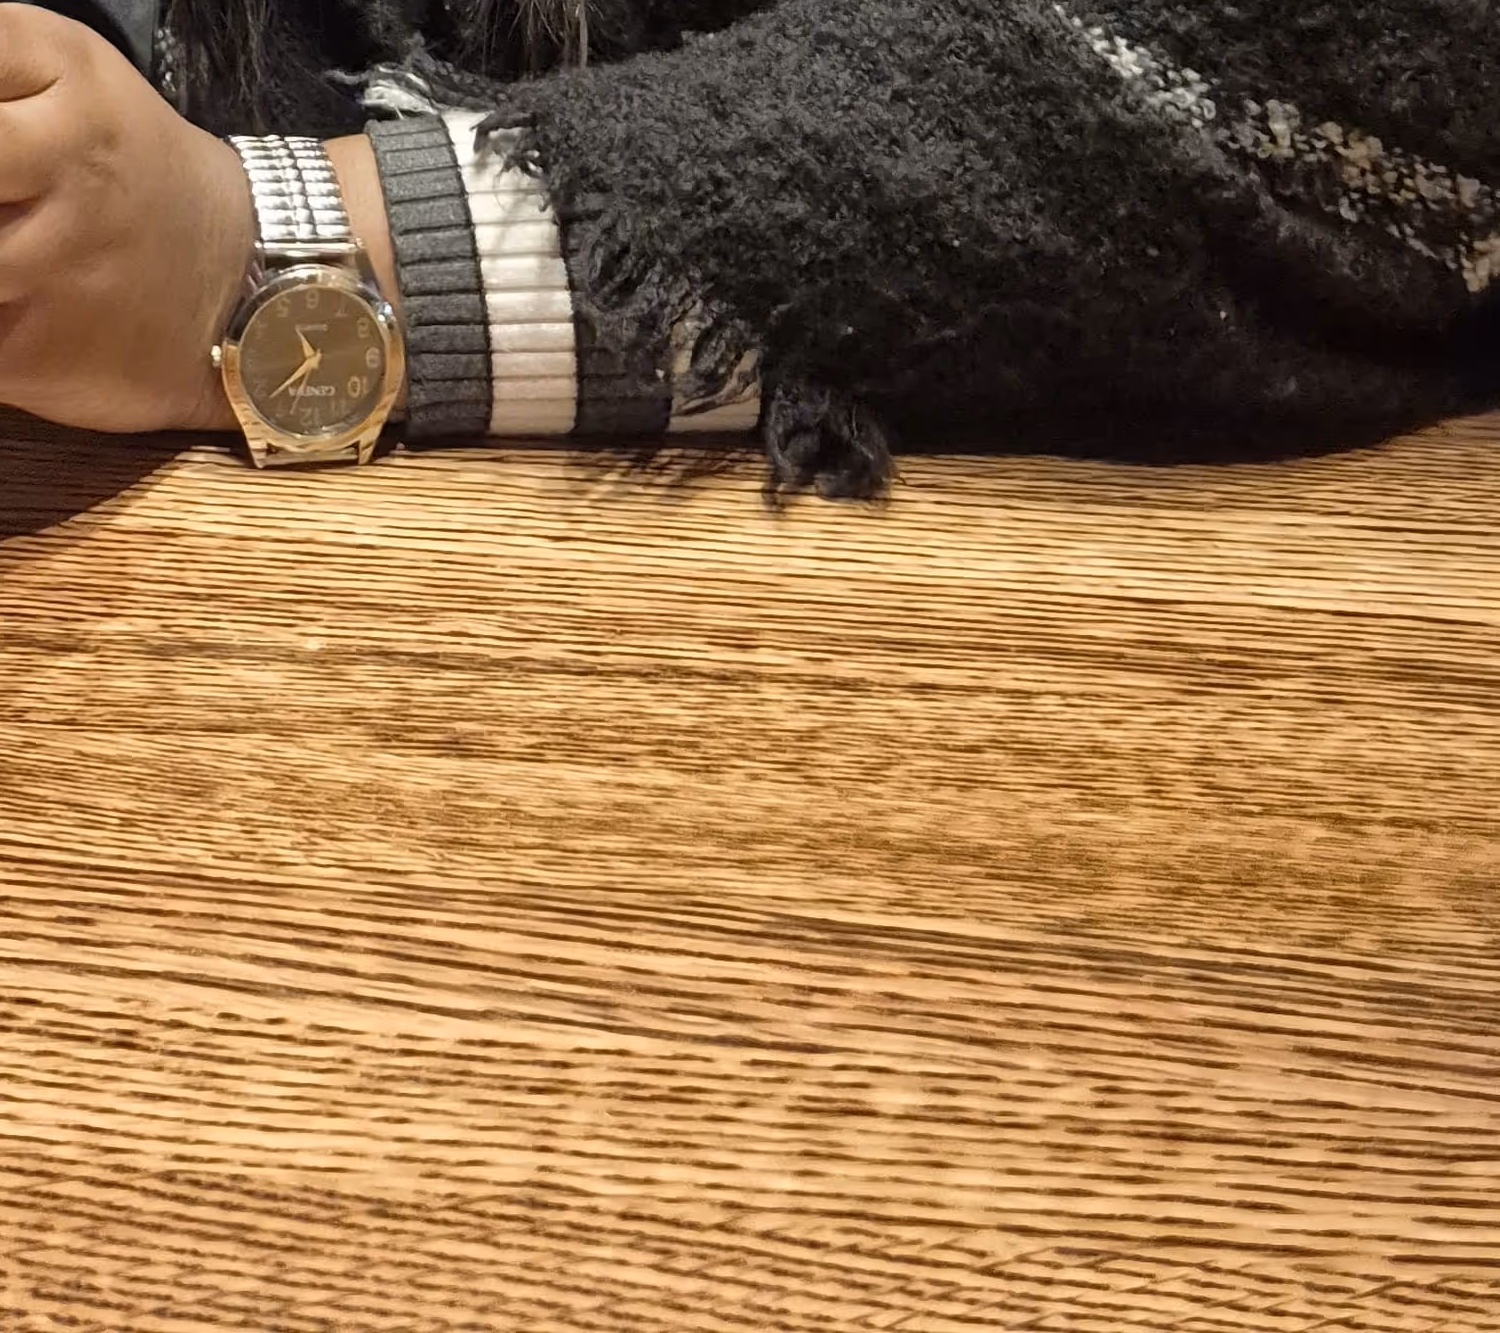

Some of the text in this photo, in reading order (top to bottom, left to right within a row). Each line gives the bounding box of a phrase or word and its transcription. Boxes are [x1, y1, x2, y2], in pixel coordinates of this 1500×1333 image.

[305, 288, 319, 310] 6
[365, 346, 381, 369] 9
[288, 385, 336, 397] GENEVA
[347, 375, 370, 398] 10
